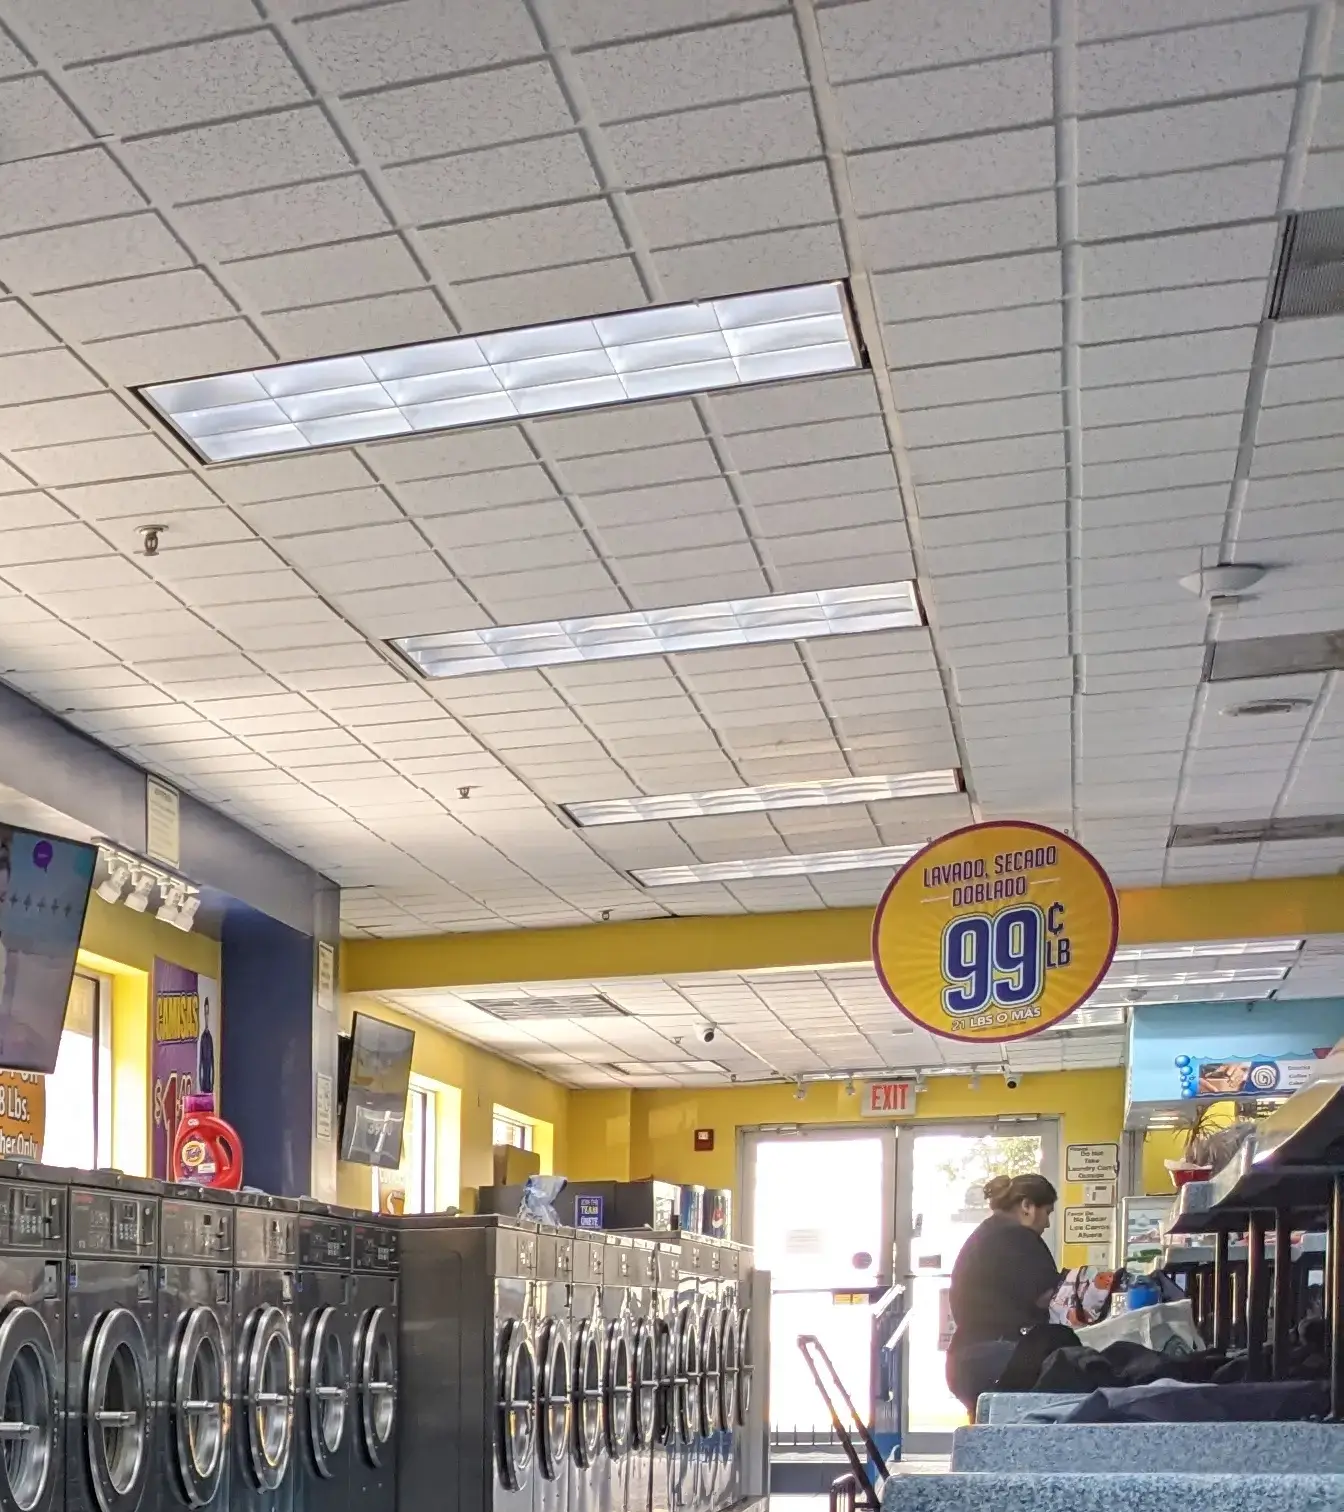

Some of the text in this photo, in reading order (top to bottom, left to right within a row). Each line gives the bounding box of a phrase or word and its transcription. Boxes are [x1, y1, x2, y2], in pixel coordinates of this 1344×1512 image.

[923, 845, 1056, 887] LAVADO, SECADO
[952, 876, 1026, 907] DOBLADO
[1046, 938, 1070, 968] LB
[952, 1020, 965, 1031] 21
[970, 1015, 993, 1027] LBS
[996, 1012, 1008, 1023] O
[8, 1087, 30, 1122] Lbs.
[872, 1084, 908, 1110] EXIT
[17, 1133, 38, 1159] Only
